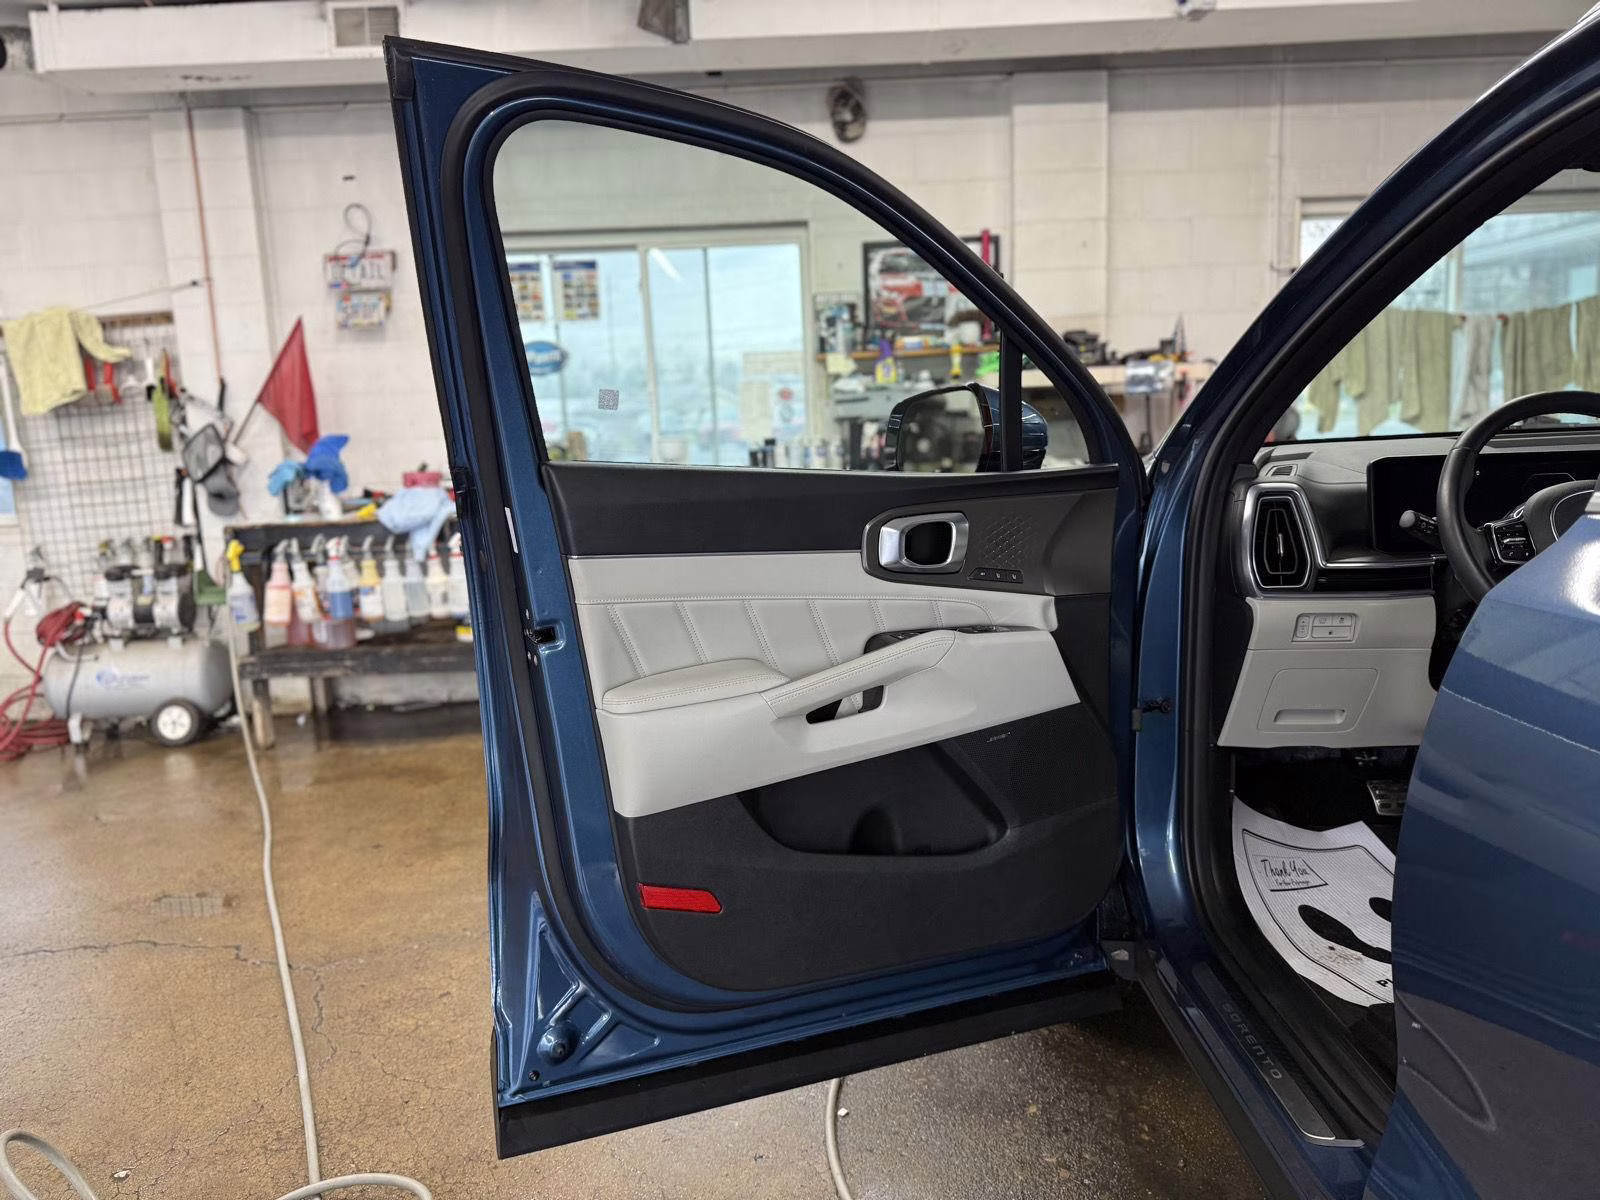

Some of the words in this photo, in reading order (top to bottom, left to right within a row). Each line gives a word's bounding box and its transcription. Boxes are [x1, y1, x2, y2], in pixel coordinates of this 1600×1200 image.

[1261, 859, 1290, 877] Thank
[1290, 860, 1310, 877] You
[1222, 1003, 1282, 1080] SORENTO
